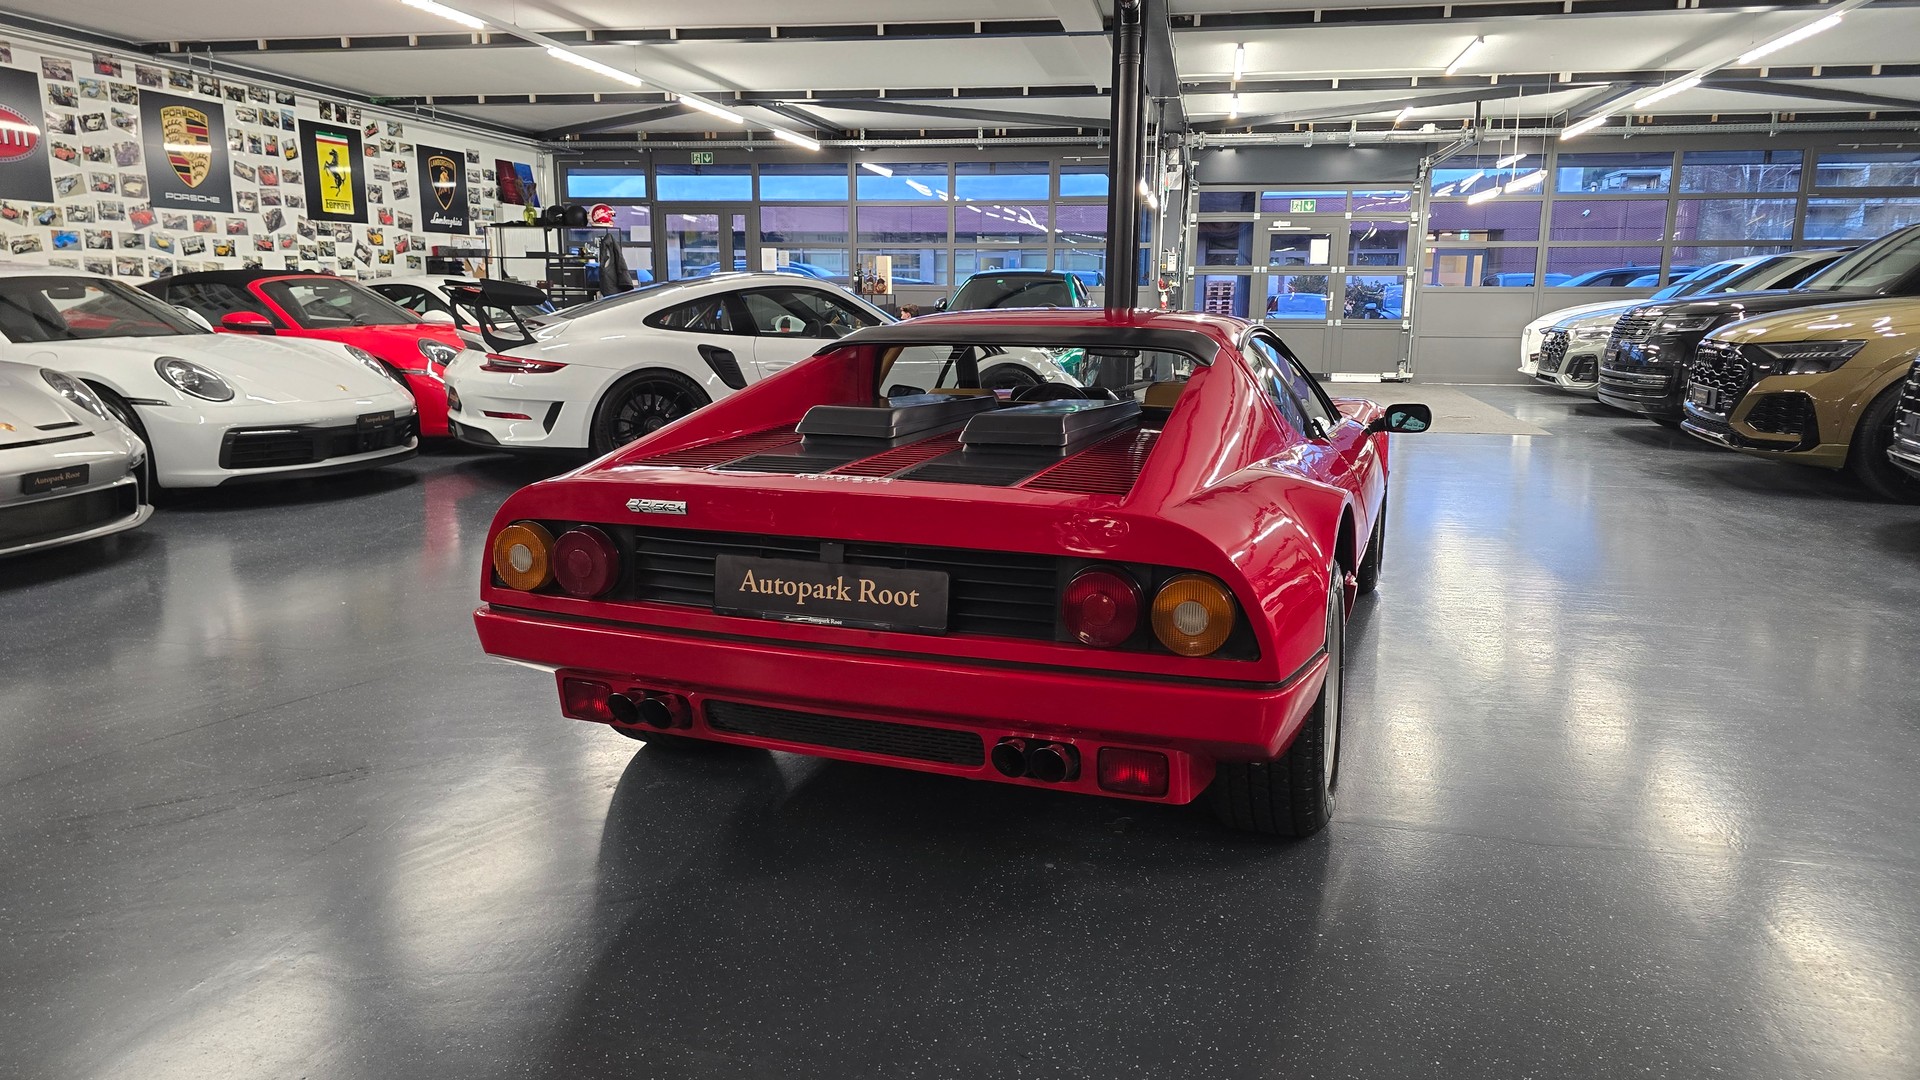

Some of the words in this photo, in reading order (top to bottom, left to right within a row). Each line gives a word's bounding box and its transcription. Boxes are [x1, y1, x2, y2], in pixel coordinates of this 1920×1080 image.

[163, 108, 206, 124] PORSCHE
[165, 192, 220, 203] PORSCHE
[325, 199, 351, 210] Ferrari
[430, 212, 463, 228] Lamborghini
[34, 473, 64, 485] Autopark
[65, 472, 80, 480] Root
[739, 569, 852, 605] Autopark
[858, 579, 920, 608] Root
